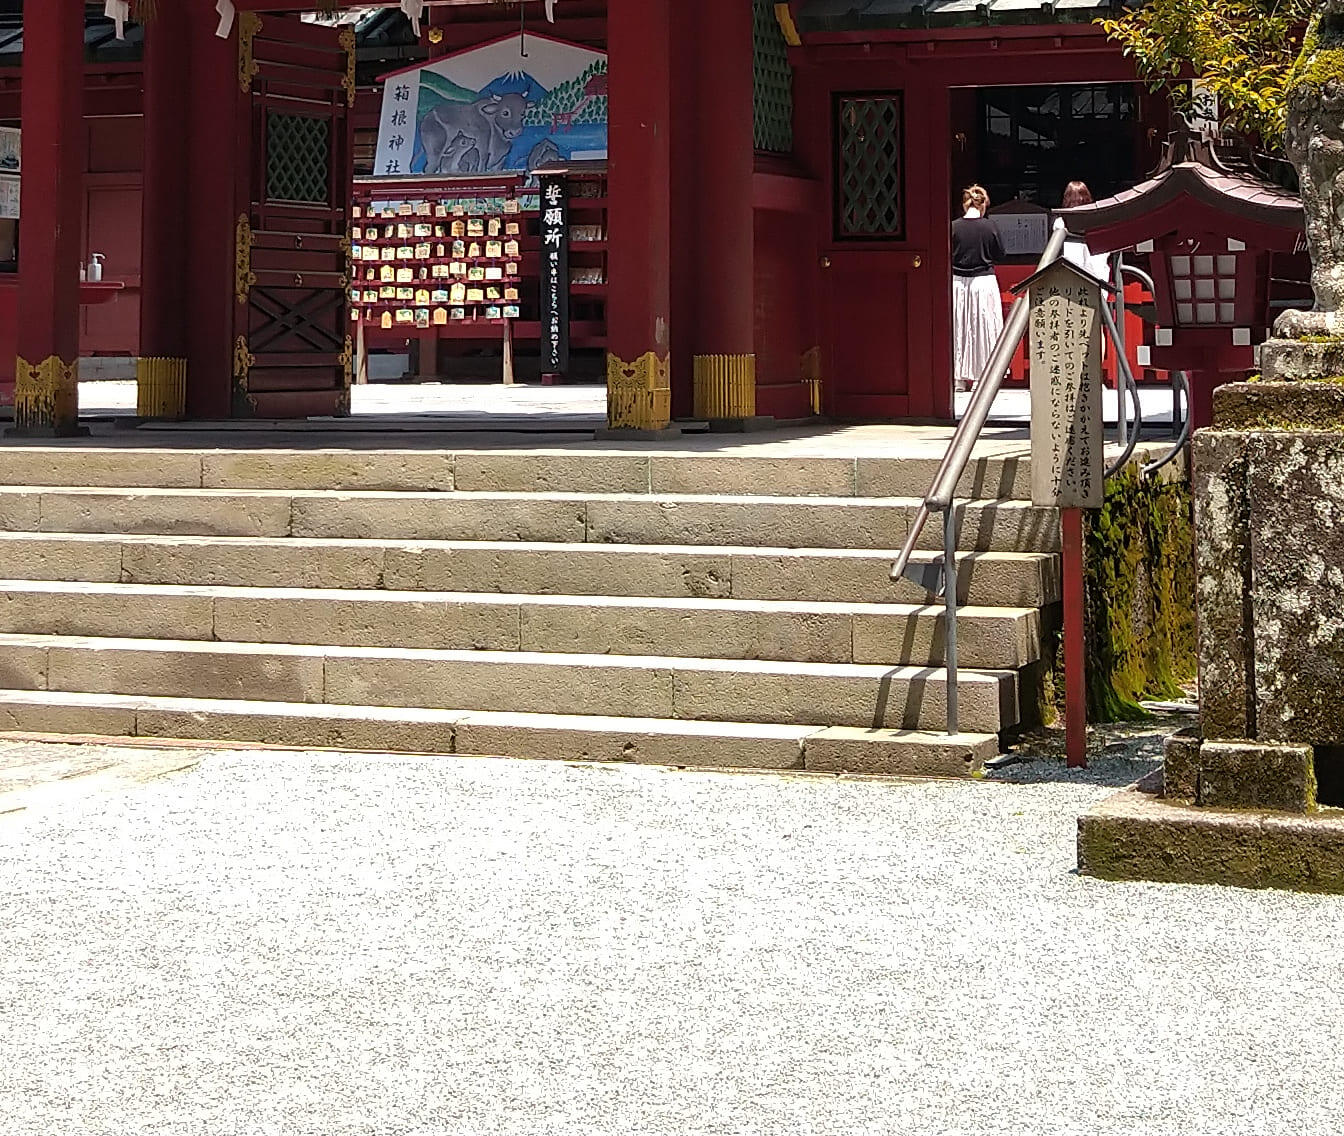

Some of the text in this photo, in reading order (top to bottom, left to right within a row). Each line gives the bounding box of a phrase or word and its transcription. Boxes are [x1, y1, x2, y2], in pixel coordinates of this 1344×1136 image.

[385, 84, 411, 174] 箱根神社
[542, 184, 564, 249] 誓願所
